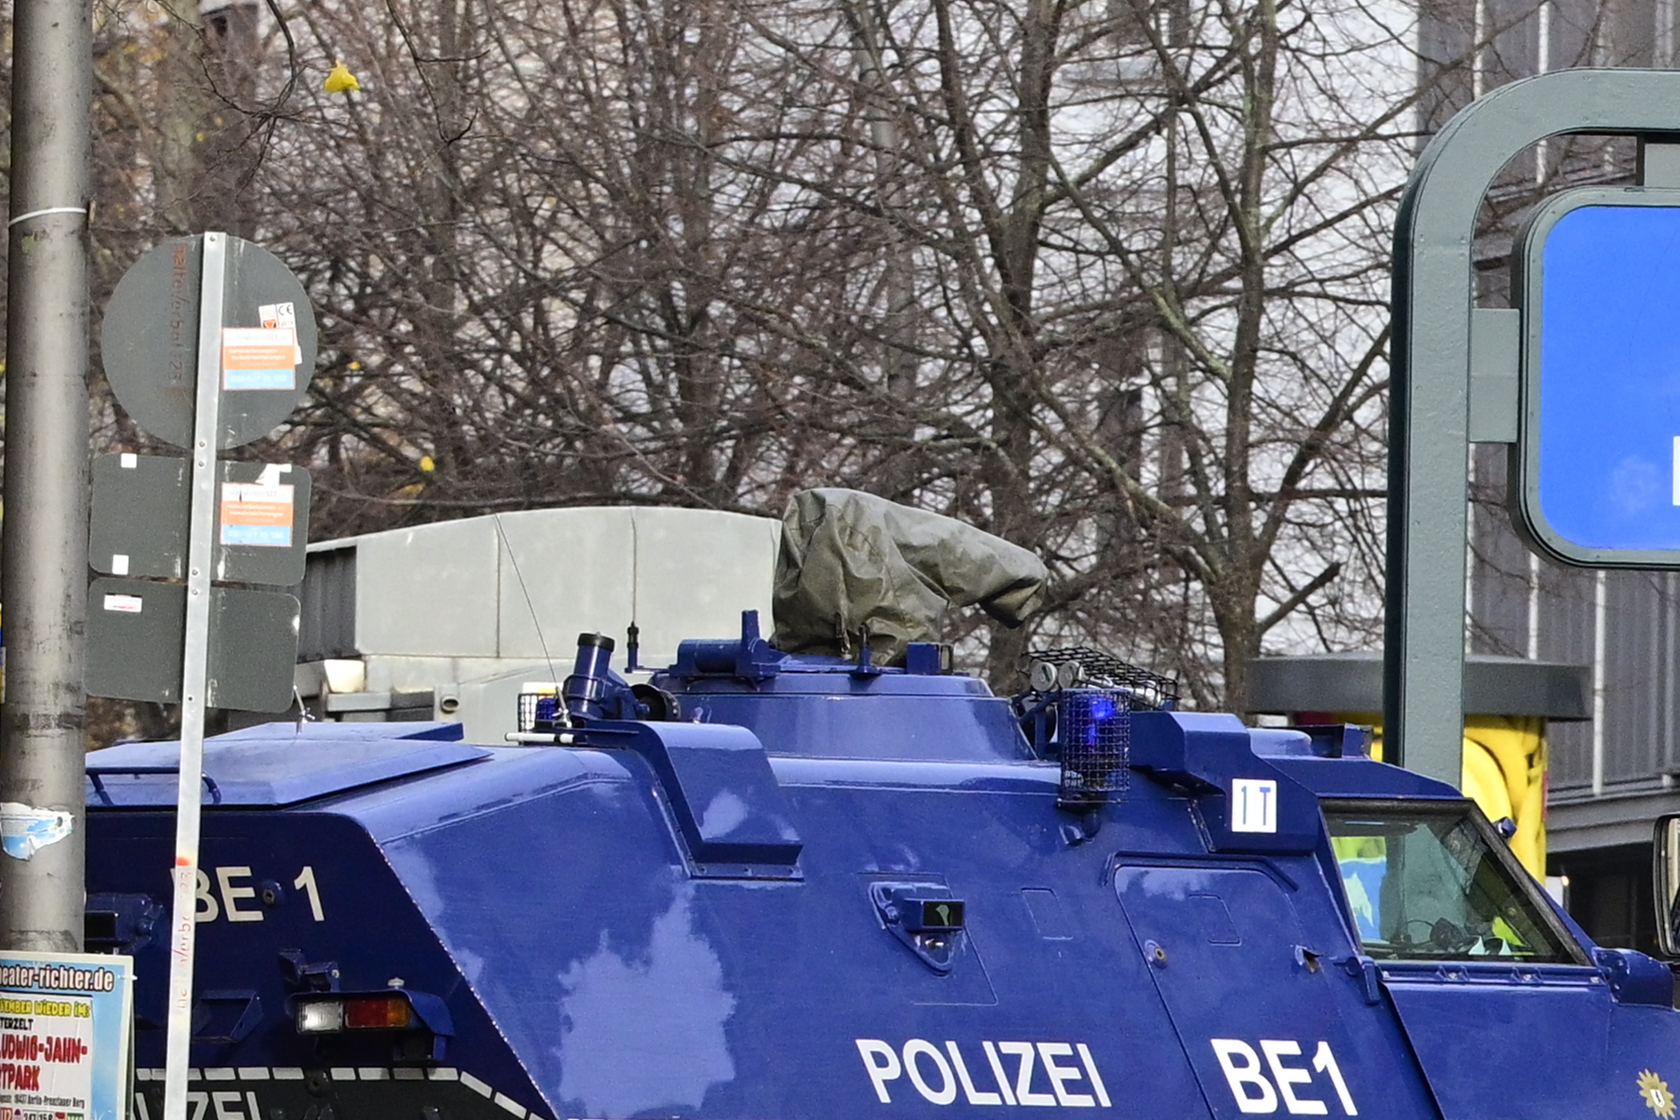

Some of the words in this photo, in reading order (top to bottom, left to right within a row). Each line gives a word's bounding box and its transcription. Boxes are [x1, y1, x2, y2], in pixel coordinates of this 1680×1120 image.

[293, 866, 325, 922] 1
[0, 1034, 88, 1063] UDWIG-JAHN-
[855, 1038, 1112, 1108] POLIZEI
[1210, 1038, 1359, 1117] BE1
